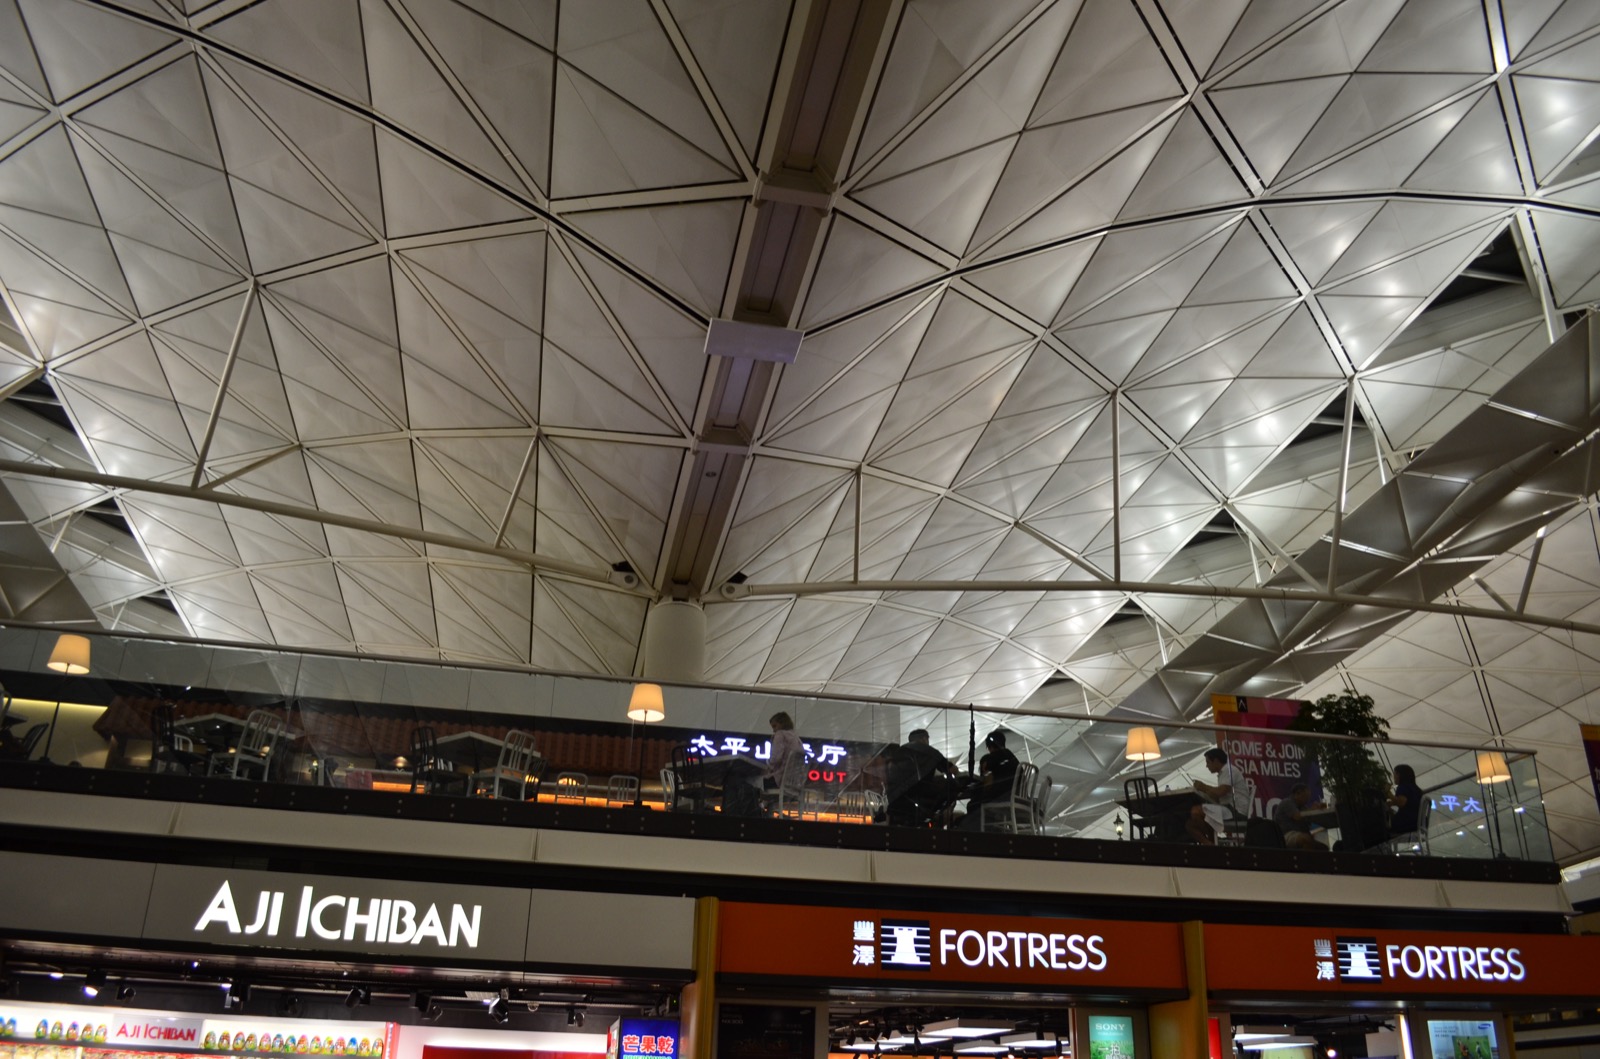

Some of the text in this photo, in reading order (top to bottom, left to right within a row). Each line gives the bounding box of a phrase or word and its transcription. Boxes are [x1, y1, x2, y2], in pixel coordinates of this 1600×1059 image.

[688, 734, 847, 766] 太平山厅
[1221, 739, 1263, 758] COME
[1265, 742, 1276, 759] &
[1234, 759, 1302, 779] SIA MILES
[194, 880, 482, 948] AJI ICHIBAN
[940, 929, 1107, 971] FORTRESS
[1386, 944, 1526, 982] FORTRESS
[116, 1022, 197, 1041] AJI ICHIBAN
[1095, 1023, 1125, 1031] SONY
[622, 1034, 674, 1055] 芒果乾
